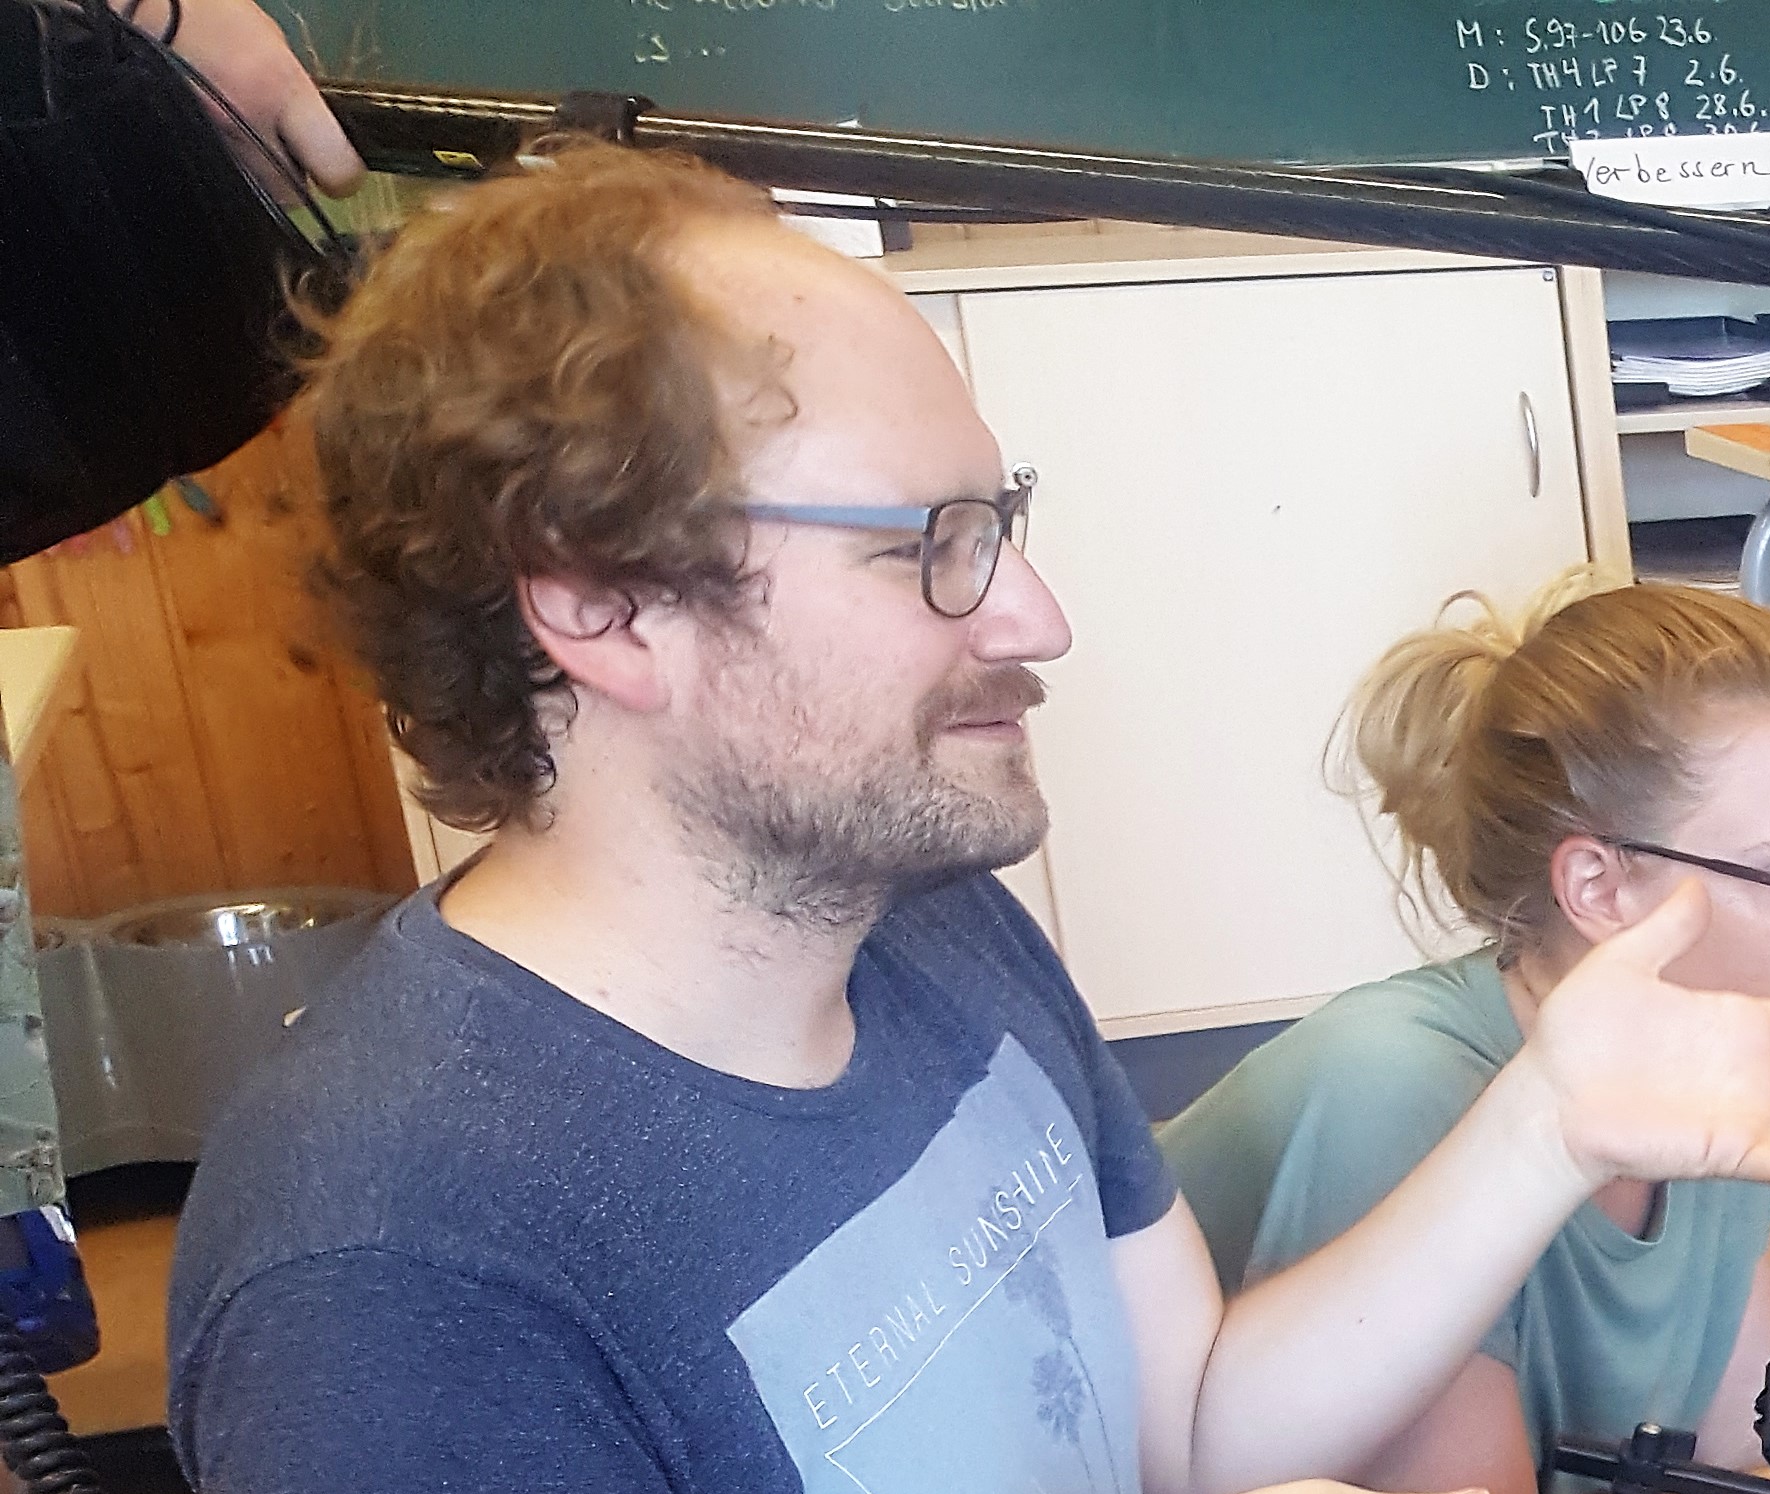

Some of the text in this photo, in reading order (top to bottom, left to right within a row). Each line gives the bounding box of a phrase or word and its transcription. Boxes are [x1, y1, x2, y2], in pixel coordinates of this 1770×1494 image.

[1633, 55, 1648, 87] 7
[1655, 91, 1670, 119] 8
[803, 1280, 946, 1429] ETERNAL
